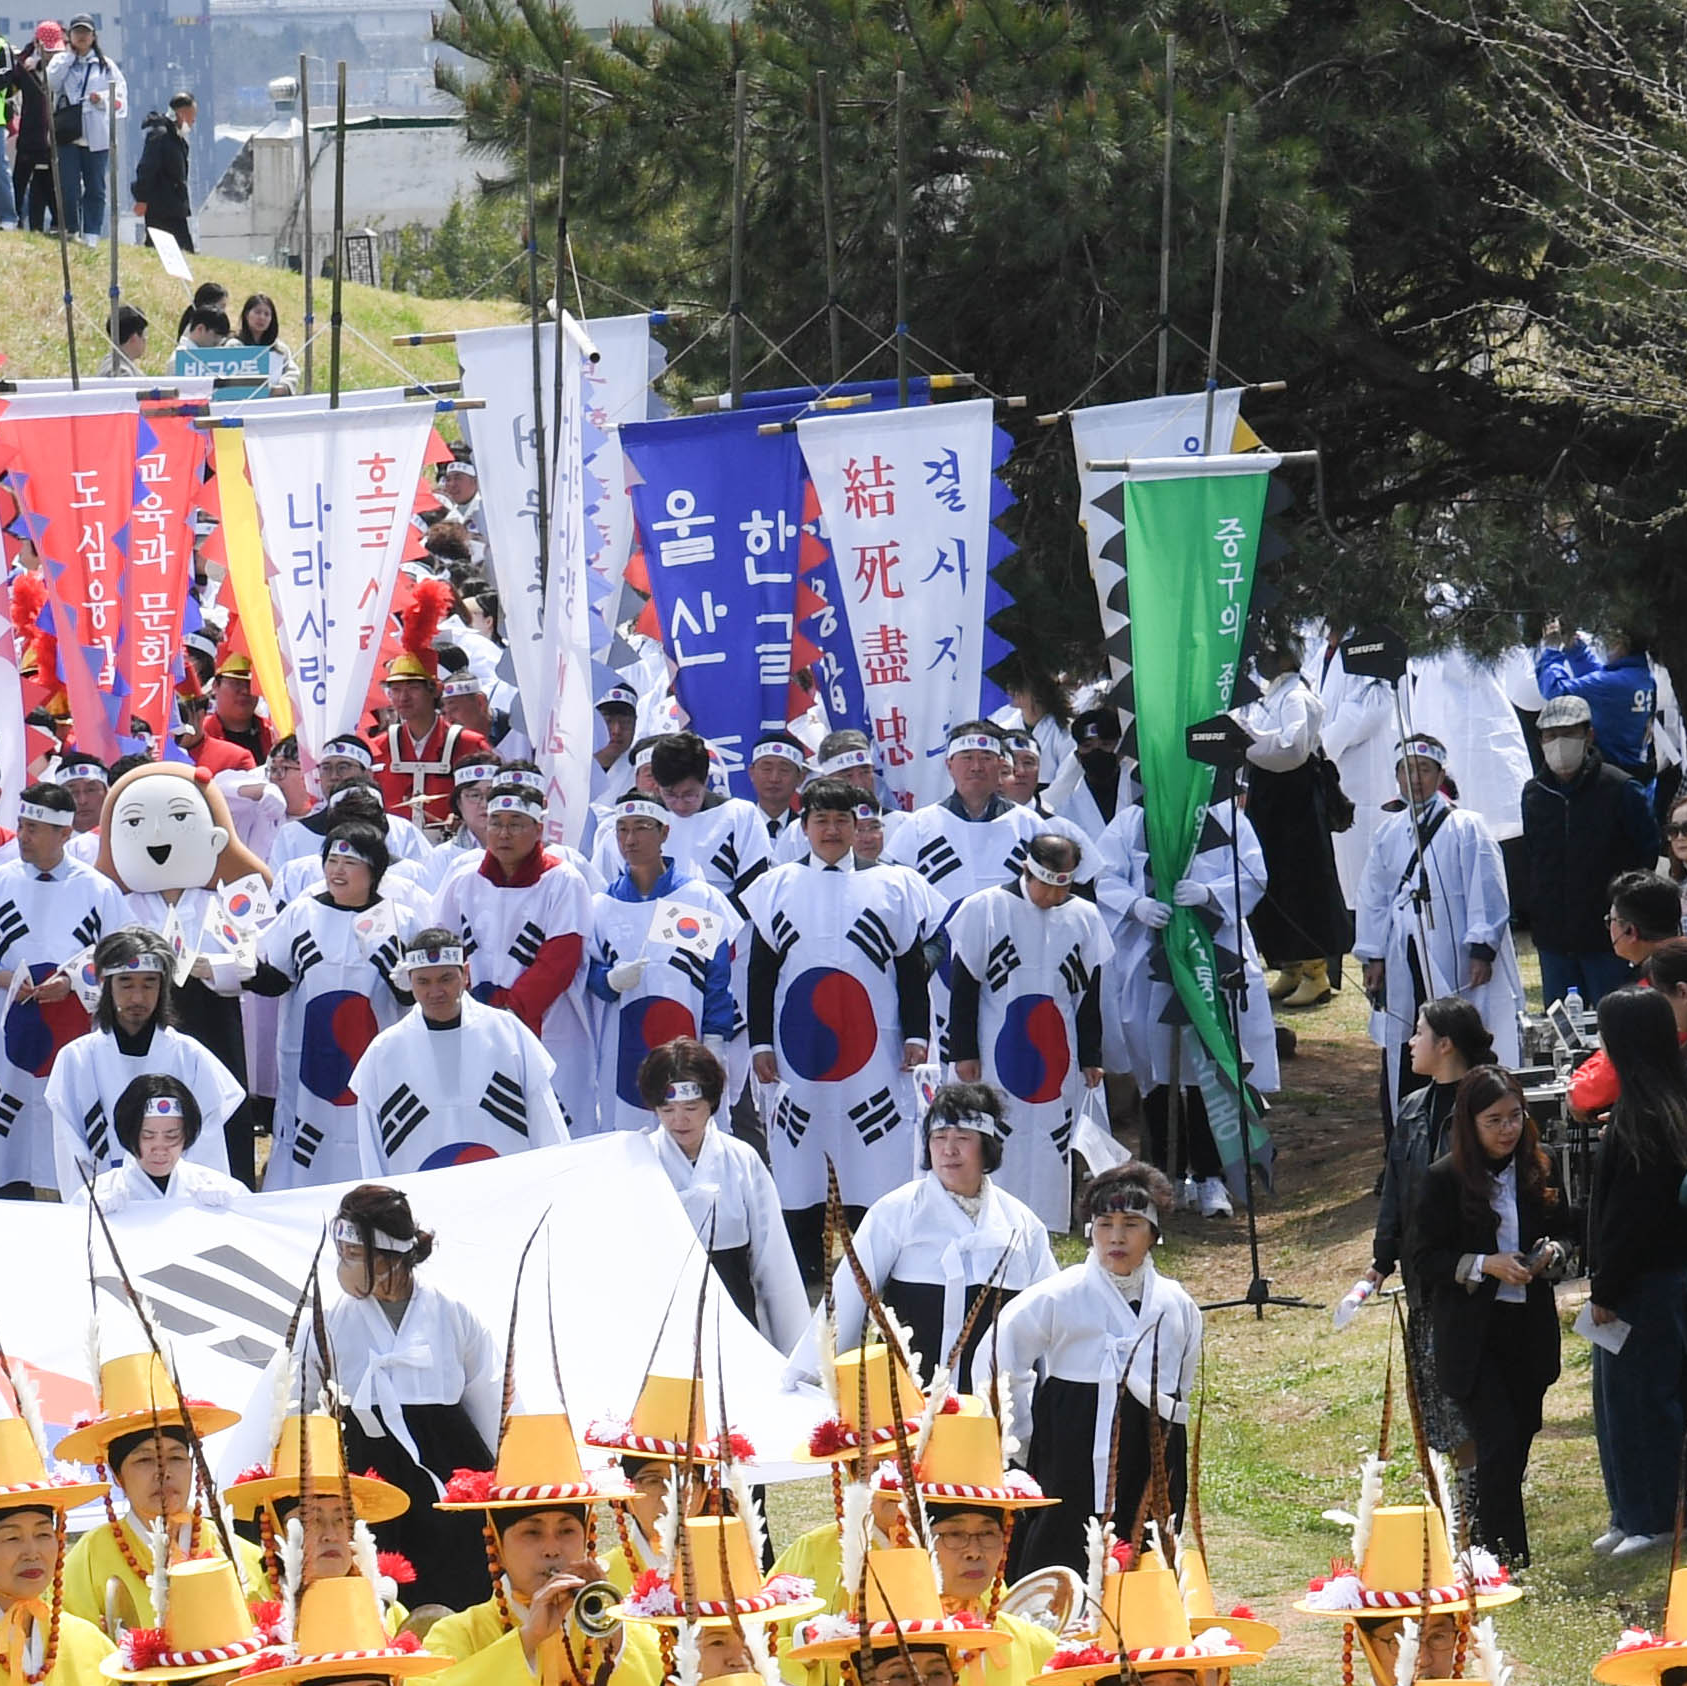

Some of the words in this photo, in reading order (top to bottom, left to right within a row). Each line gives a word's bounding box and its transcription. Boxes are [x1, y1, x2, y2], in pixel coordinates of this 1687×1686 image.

[132, 453, 176, 575] 교육과
[651, 488, 729, 669] 울산
[1213, 517, 1246, 644] 중구의
[287, 482, 337, 705] 나라사랑
[739, 509, 797, 730] 한글
[920, 447, 970, 758] 결사진
[1347, 643, 1385, 656] SHURE
[1191, 732, 1226, 742] SHURE
